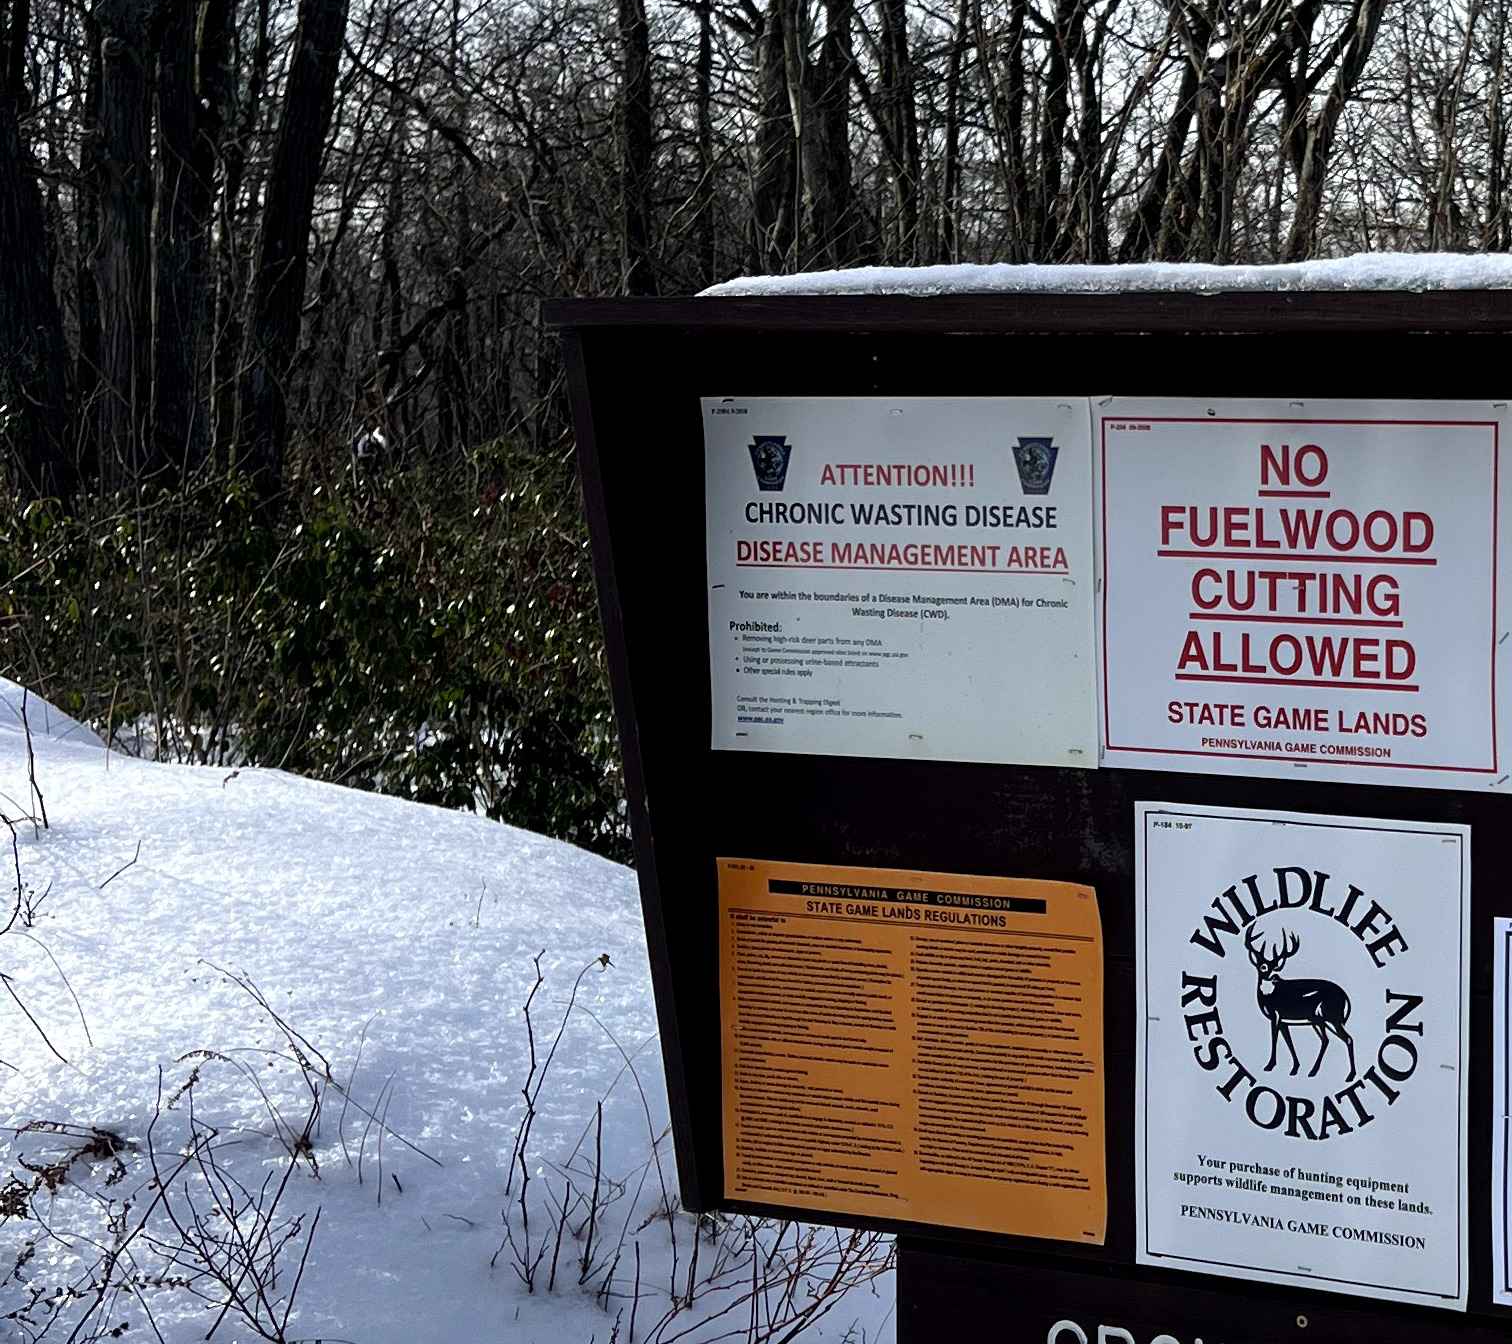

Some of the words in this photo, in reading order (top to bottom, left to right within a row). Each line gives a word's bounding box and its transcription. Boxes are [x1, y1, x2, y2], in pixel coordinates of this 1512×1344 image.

[821, 464, 974, 487] ATTENTION!!!
[1260, 444, 1328, 487] NO
[745, 503, 844, 525] CHRONIC
[851, 504, 957, 527] WASTING
[965, 505, 1056, 528] DISEASE
[1161, 506, 1434, 554] FUELWOOD
[737, 541, 823, 564] DISEASE
[831, 543, 1000, 567] MANAGEMENT
[1007, 546, 1068, 569] AREA
[740, 591, 754, 599] You
[771, 592, 796, 600] within
[799, 592, 811, 600] the
[814, 592, 859, 602] boundaries
[861, 593, 870, 602] of
[879, 595, 910, 603] Disease
[913, 595, 967, 606] Management
[970, 596, 989, 606] Area
[992, 596, 1019, 608] (DMA)
[1022, 597, 1033, 607] for
[1036, 598, 1068, 608] Chronic
[1191, 569, 1400, 616] CUTTING
[729, 621, 782, 632] Prohibited:
[852, 607, 885, 618] Wasting
[887, 608, 918, 619] Disease
[1177, 630, 1416, 681] ALLOWED
[1168, 701, 1245, 727] STATE
[1254, 706, 1329, 732] GAME
[1338, 710, 1427, 737] LANDS
[1201, 737, 1282, 752] PENNSYLVANIA
[1285, 741, 1316, 754] GAME
[1320, 743, 1391, 758] COMMISSION
[802, 884, 888, 900] PENNSYLVANIA
[897, 890, 929, 902] GAME
[937, 894, 1010, 909] COMMISSION
[807, 901, 842, 915] STATE
[846, 903, 878, 918] GAME
[882, 905, 920, 920] LANDS
[924, 909, 1006, 927] REGULATIONS
[1190, 866, 1408, 968] WILDLIFE
[1181, 971, 1424, 1140] RESTORATION
[1173, 1170, 1223, 1188] supports
[1225, 1176, 1268, 1194] wildlife
[1270, 1182, 1343, 1202] management
[1347, 1194, 1361, 1205] on
[1365, 1194, 1395, 1208] these
[1398, 1198, 1433, 1215] lands.
[1197, 1154, 1226, 1170] Your
[1229, 1158, 1280, 1179] purchase
[1284, 1165, 1296, 1179] of
[1298, 1168, 1343, 1189] hunting
[1346, 1175, 1409, 1195] equipment
[1181, 1204, 1284, 1231] PENNSYLVANIA
[1287, 1218, 1329, 1237] GAME
[1332, 1224, 1426, 1250] COMMISSION
